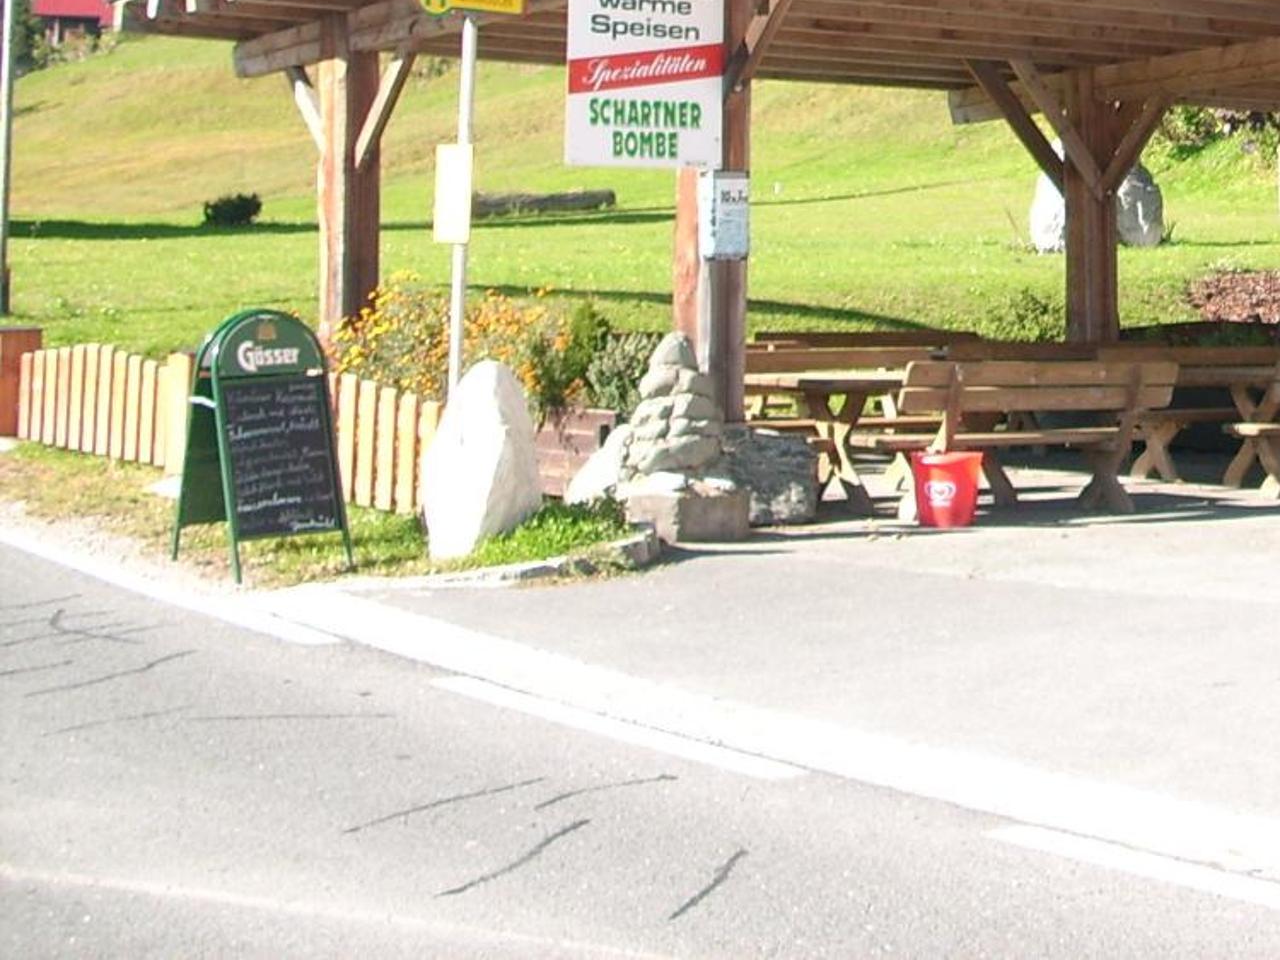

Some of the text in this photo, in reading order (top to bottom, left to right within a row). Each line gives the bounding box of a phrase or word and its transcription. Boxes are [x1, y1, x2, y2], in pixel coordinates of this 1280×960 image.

[591, 15, 699, 40] Speisen
[583, 52, 707, 90] Spezialitäten
[589, 98, 702, 129] SCHARTNER
[612, 131, 679, 158] BOMBE
[237, 341, 300, 372] Gösser
